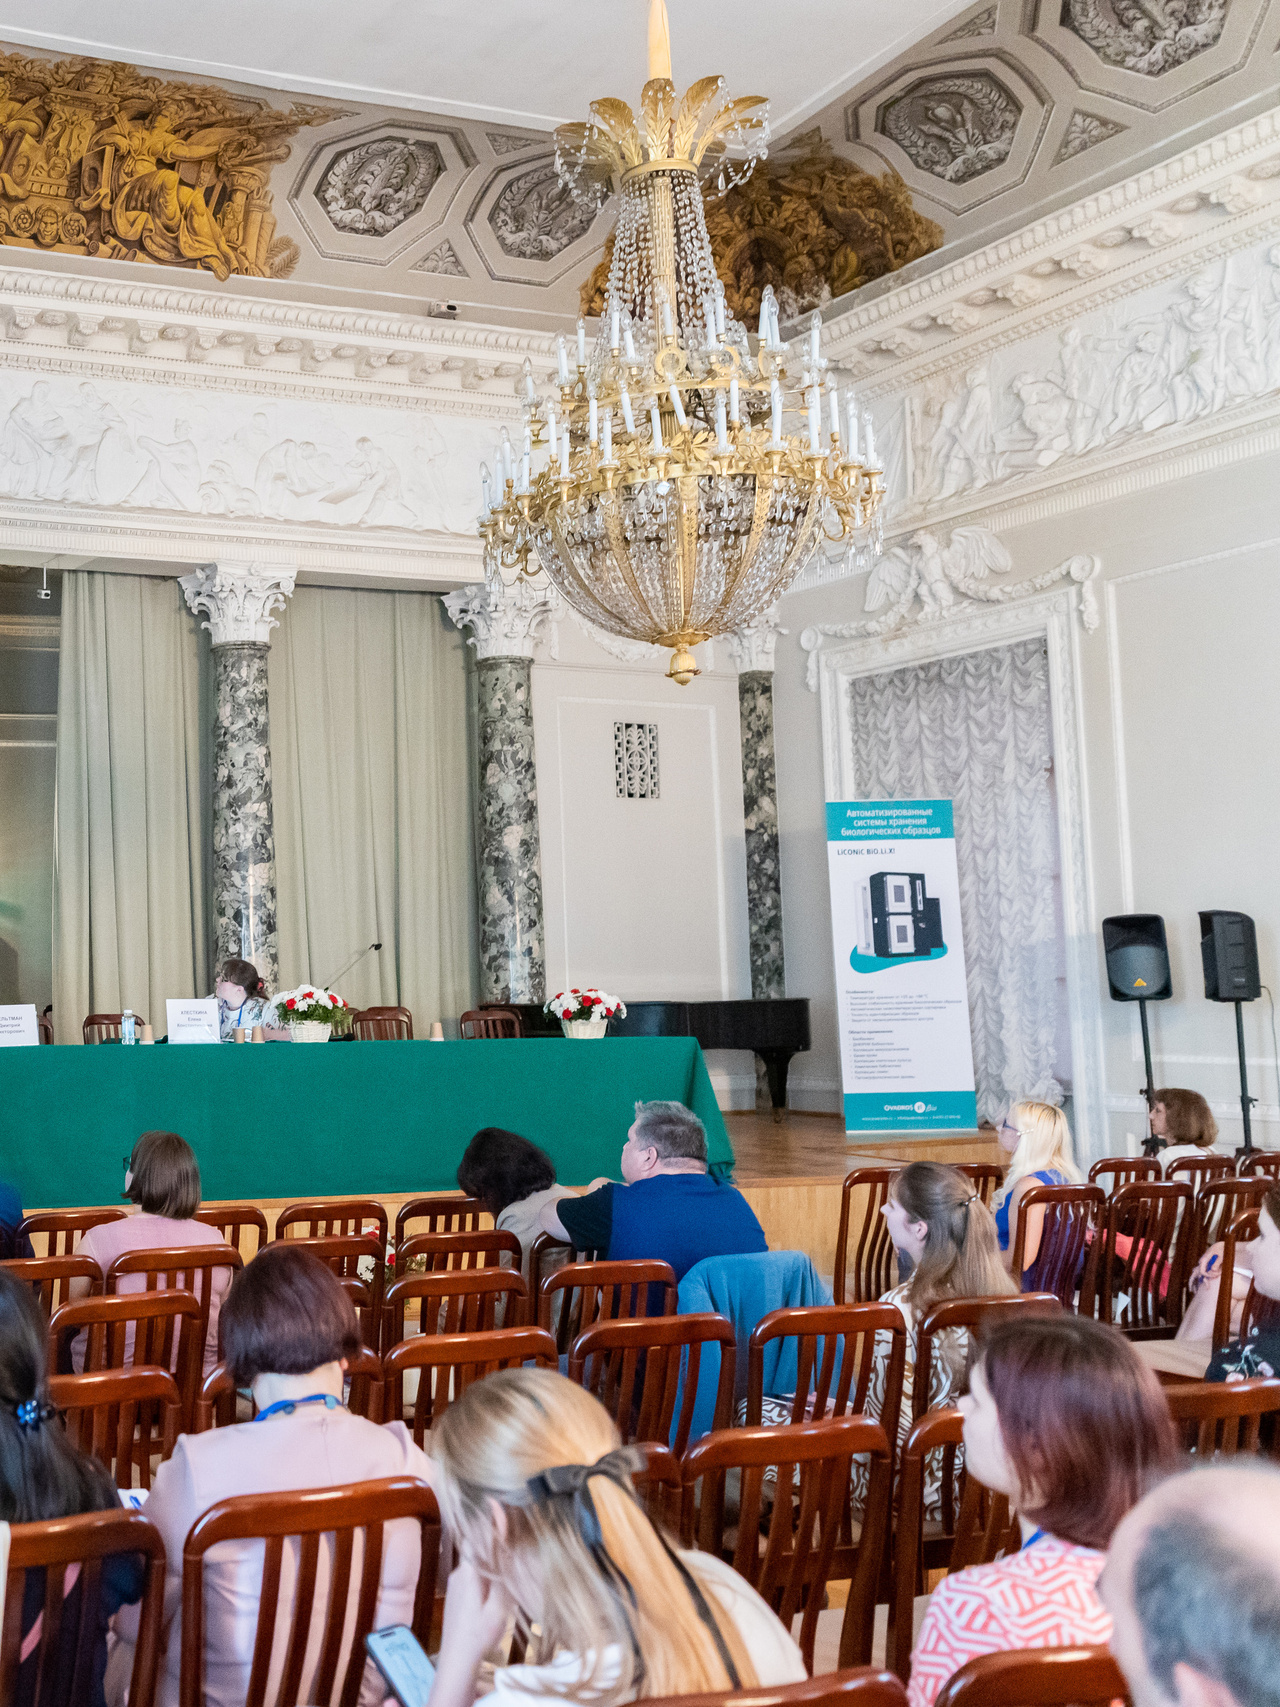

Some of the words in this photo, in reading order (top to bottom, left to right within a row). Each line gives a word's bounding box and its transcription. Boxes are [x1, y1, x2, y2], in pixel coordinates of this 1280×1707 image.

[847, 808, 933, 818] Автоматизированные
[854, 819, 887, 827] системы
[889, 818, 927, 827] хранения
[841, 827, 901, 836] биологических
[903, 826, 941, 836] образцов
